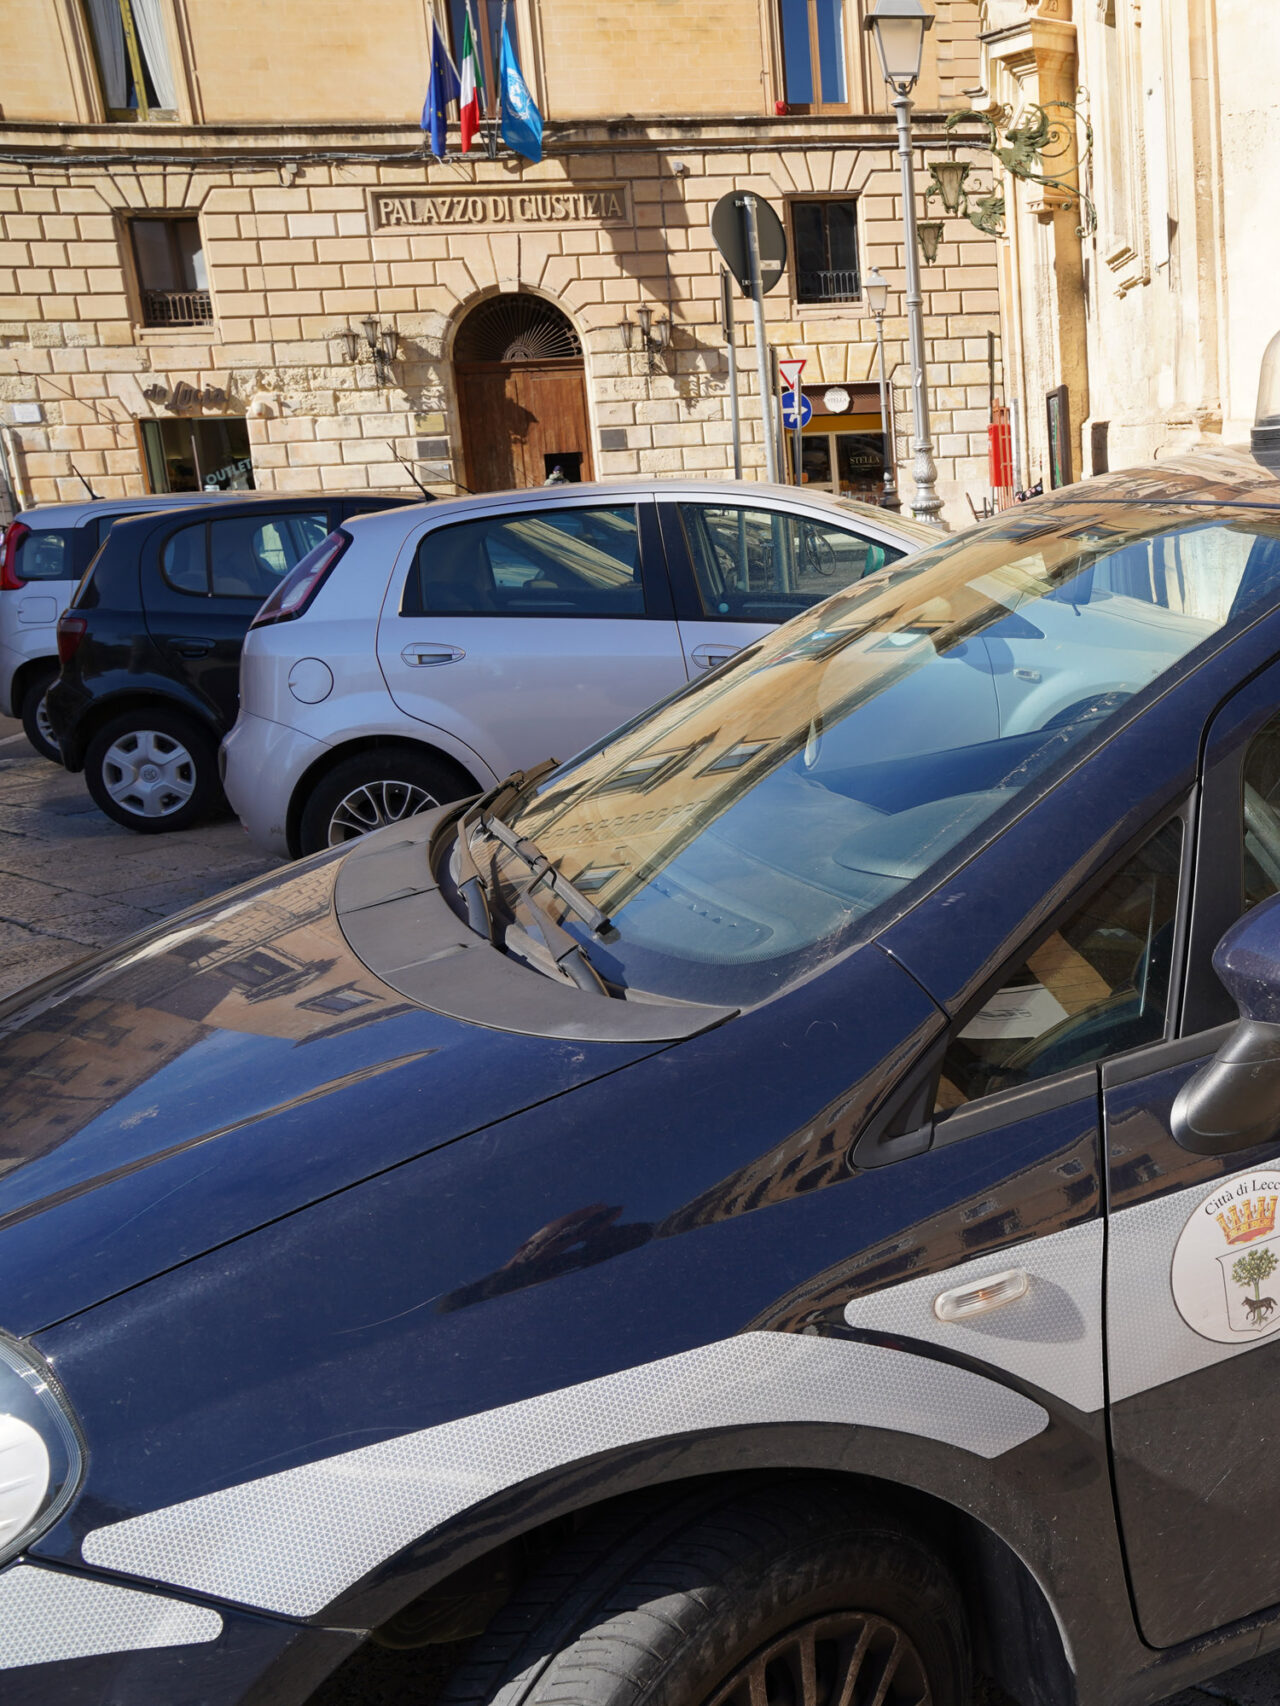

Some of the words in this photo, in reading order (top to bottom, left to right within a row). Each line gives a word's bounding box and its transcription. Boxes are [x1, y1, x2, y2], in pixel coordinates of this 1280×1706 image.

[379, 197, 485, 225] PALAZZO
[492, 196, 511, 221] DI
[519, 192, 623, 222] GIUSTIZIA
[164, 381, 229, 411] Lucia
[206, 458, 252, 485] OUTLET
[849, 456, 881, 465] STELLA
[1204, 1190, 1234, 1216] Città
[1236, 1182, 1249, 1197] di
